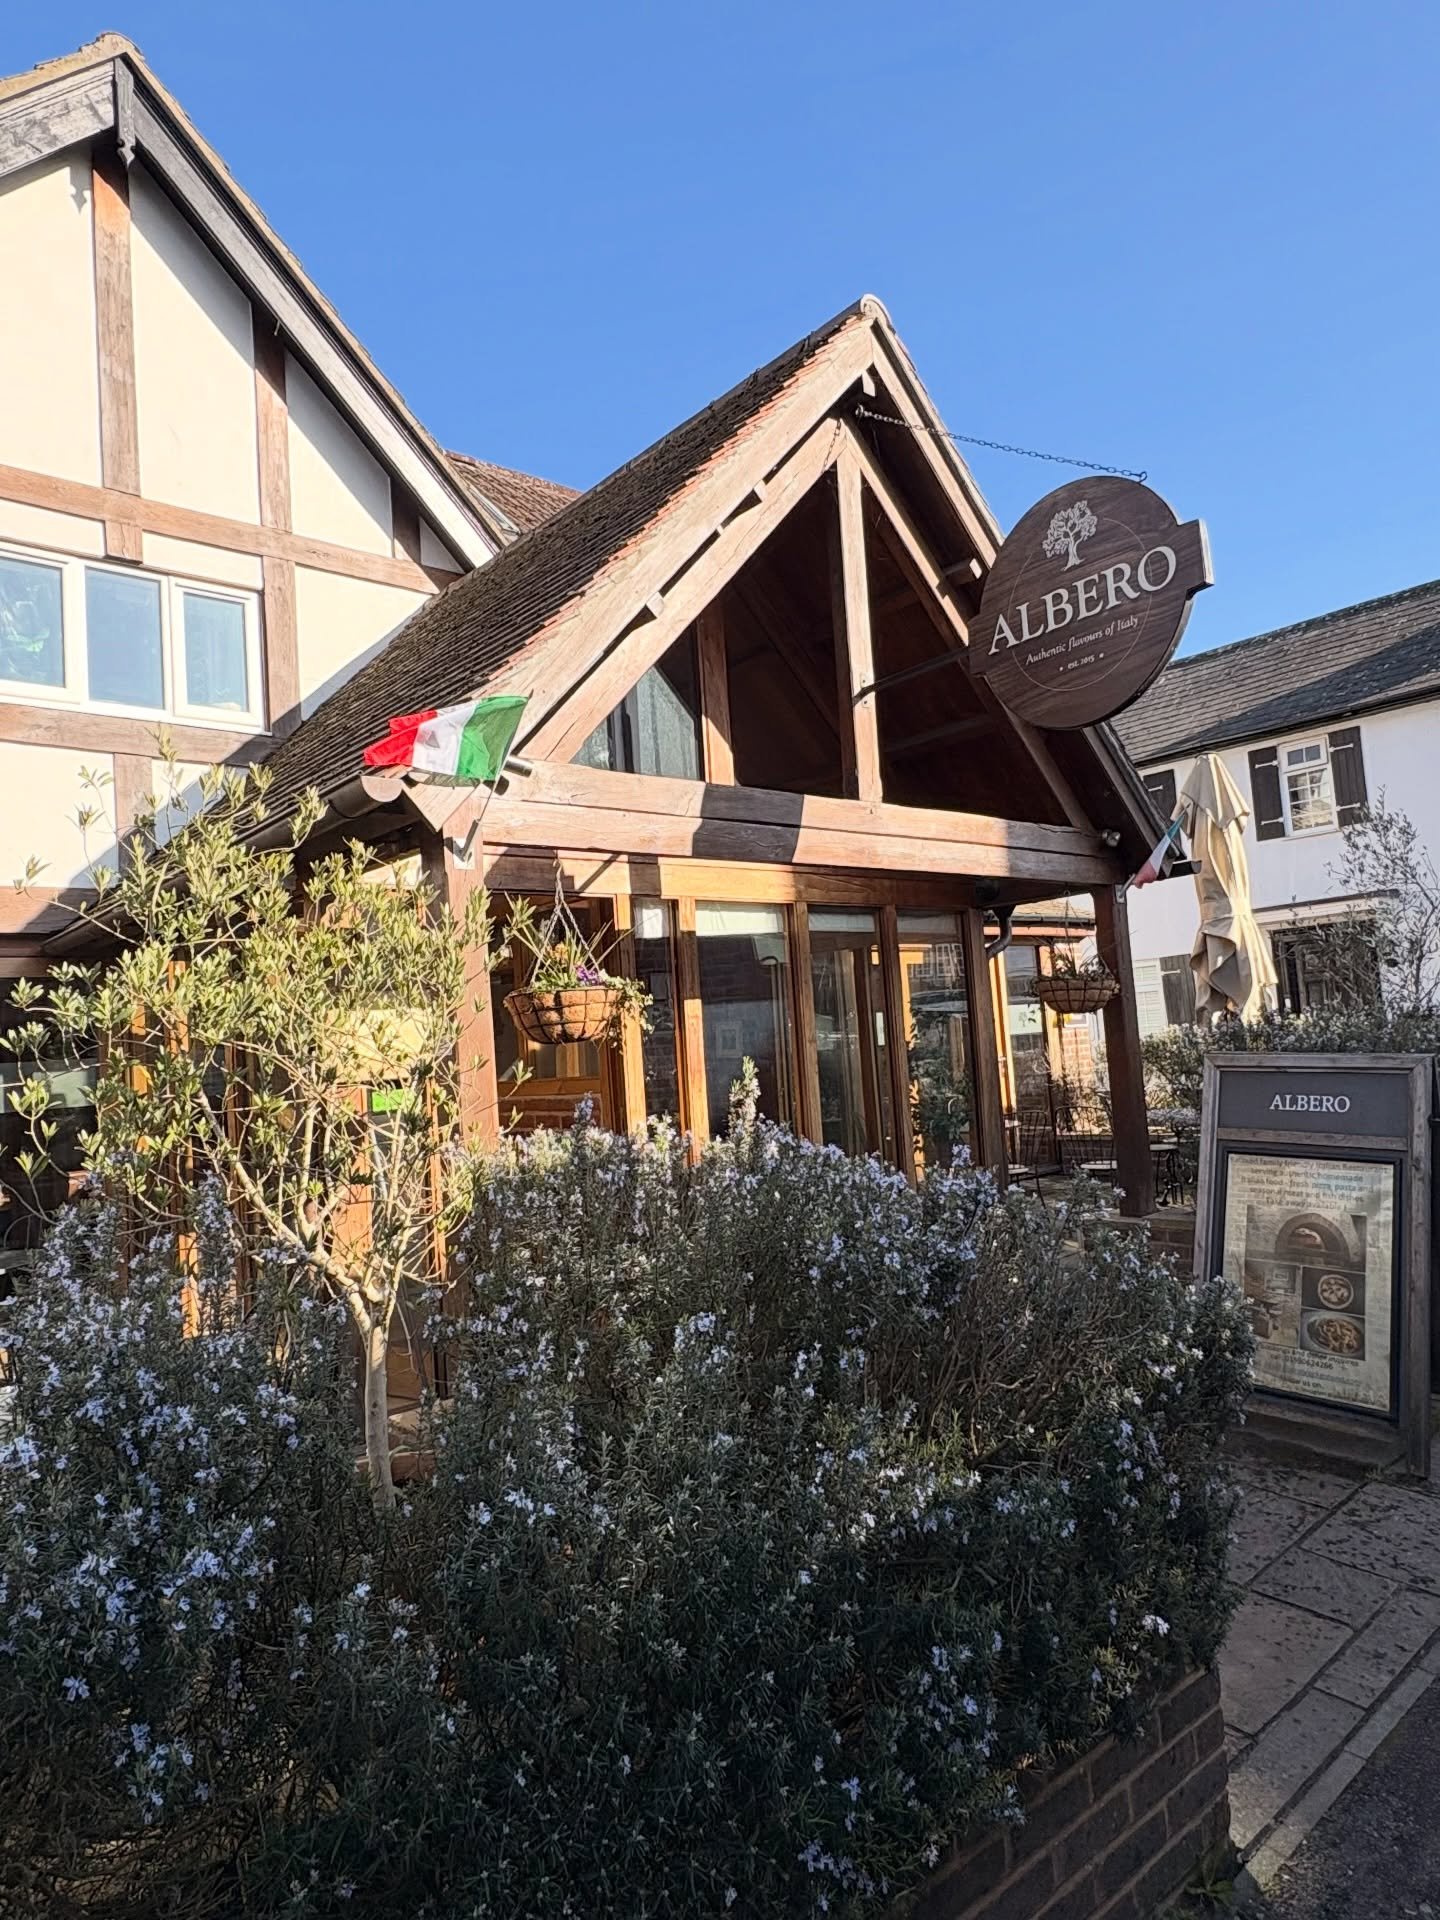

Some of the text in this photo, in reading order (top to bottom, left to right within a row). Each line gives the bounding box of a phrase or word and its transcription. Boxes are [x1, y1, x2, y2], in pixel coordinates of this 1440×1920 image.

[988, 546, 1177, 655] ALBERO
[1025, 615, 1139, 666] Authentic flavours of Italy
[1269, 1094, 1351, 1113] ALBERO
[1279, 1169, 1316, 1180] ahentic
[1334, 1184, 1356, 1193] pasta
